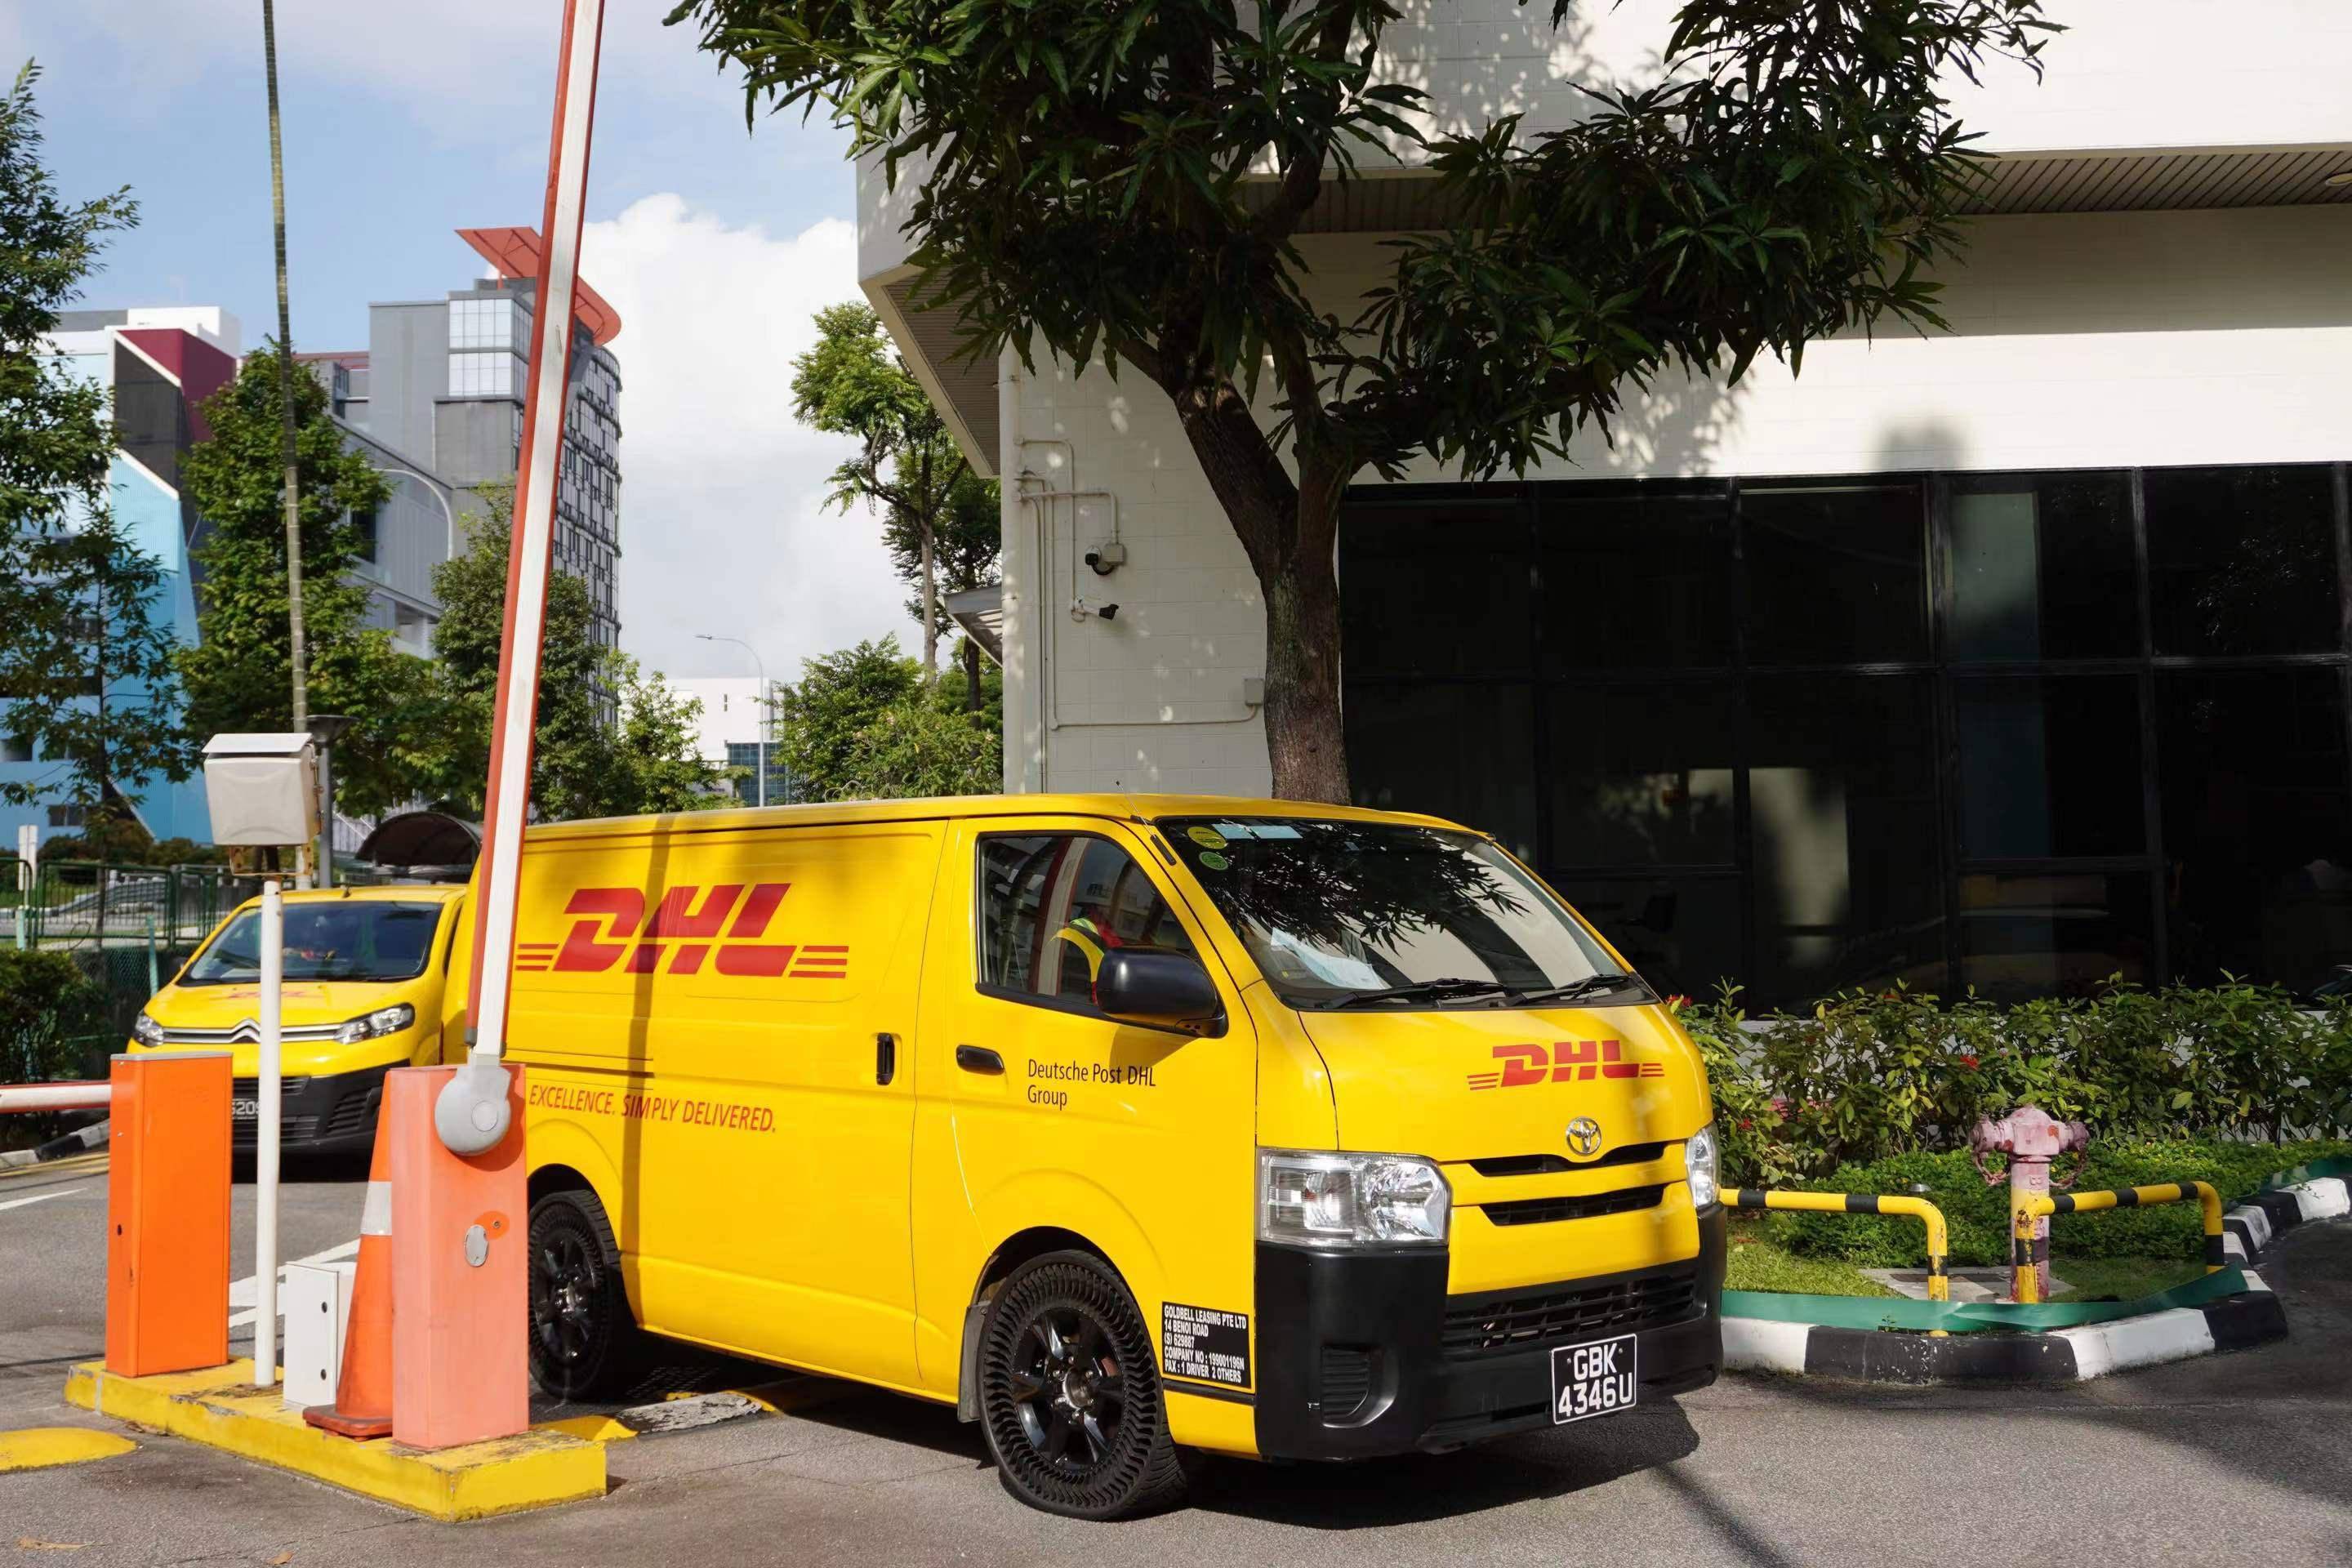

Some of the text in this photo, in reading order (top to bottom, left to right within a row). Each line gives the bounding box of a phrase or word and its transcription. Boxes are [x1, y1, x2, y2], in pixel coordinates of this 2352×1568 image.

[552, 883, 797, 977] DHL
[1028, 1059, 1156, 1086] Deutsche Post DHL
[1493, 1040, 1640, 1087] DHL
[528, 1085, 776, 1133] EXCELLENCE. SIMPLY DELIVERED.
[1027, 1085, 1067, 1111] Group
[1164, 1305, 1247, 1330] GOLDBELL LEASING PTE LTD
[1164, 1319, 1209, 1337] 14 BENOI ROAD
[1164, 1332, 1173, 1345] (S)
[1164, 1346, 1194, 1362] COMPANY
[1573, 1343, 1617, 1381] GBK
[1165, 1359, 1177, 1373] PAX
[1186, 1362, 1209, 1378] DRIVER
[1211, 1365, 1216, 1379] 2
[1217, 1367, 1241, 1383] OTHERS
[1558, 1372, 1633, 1417] 4346U
